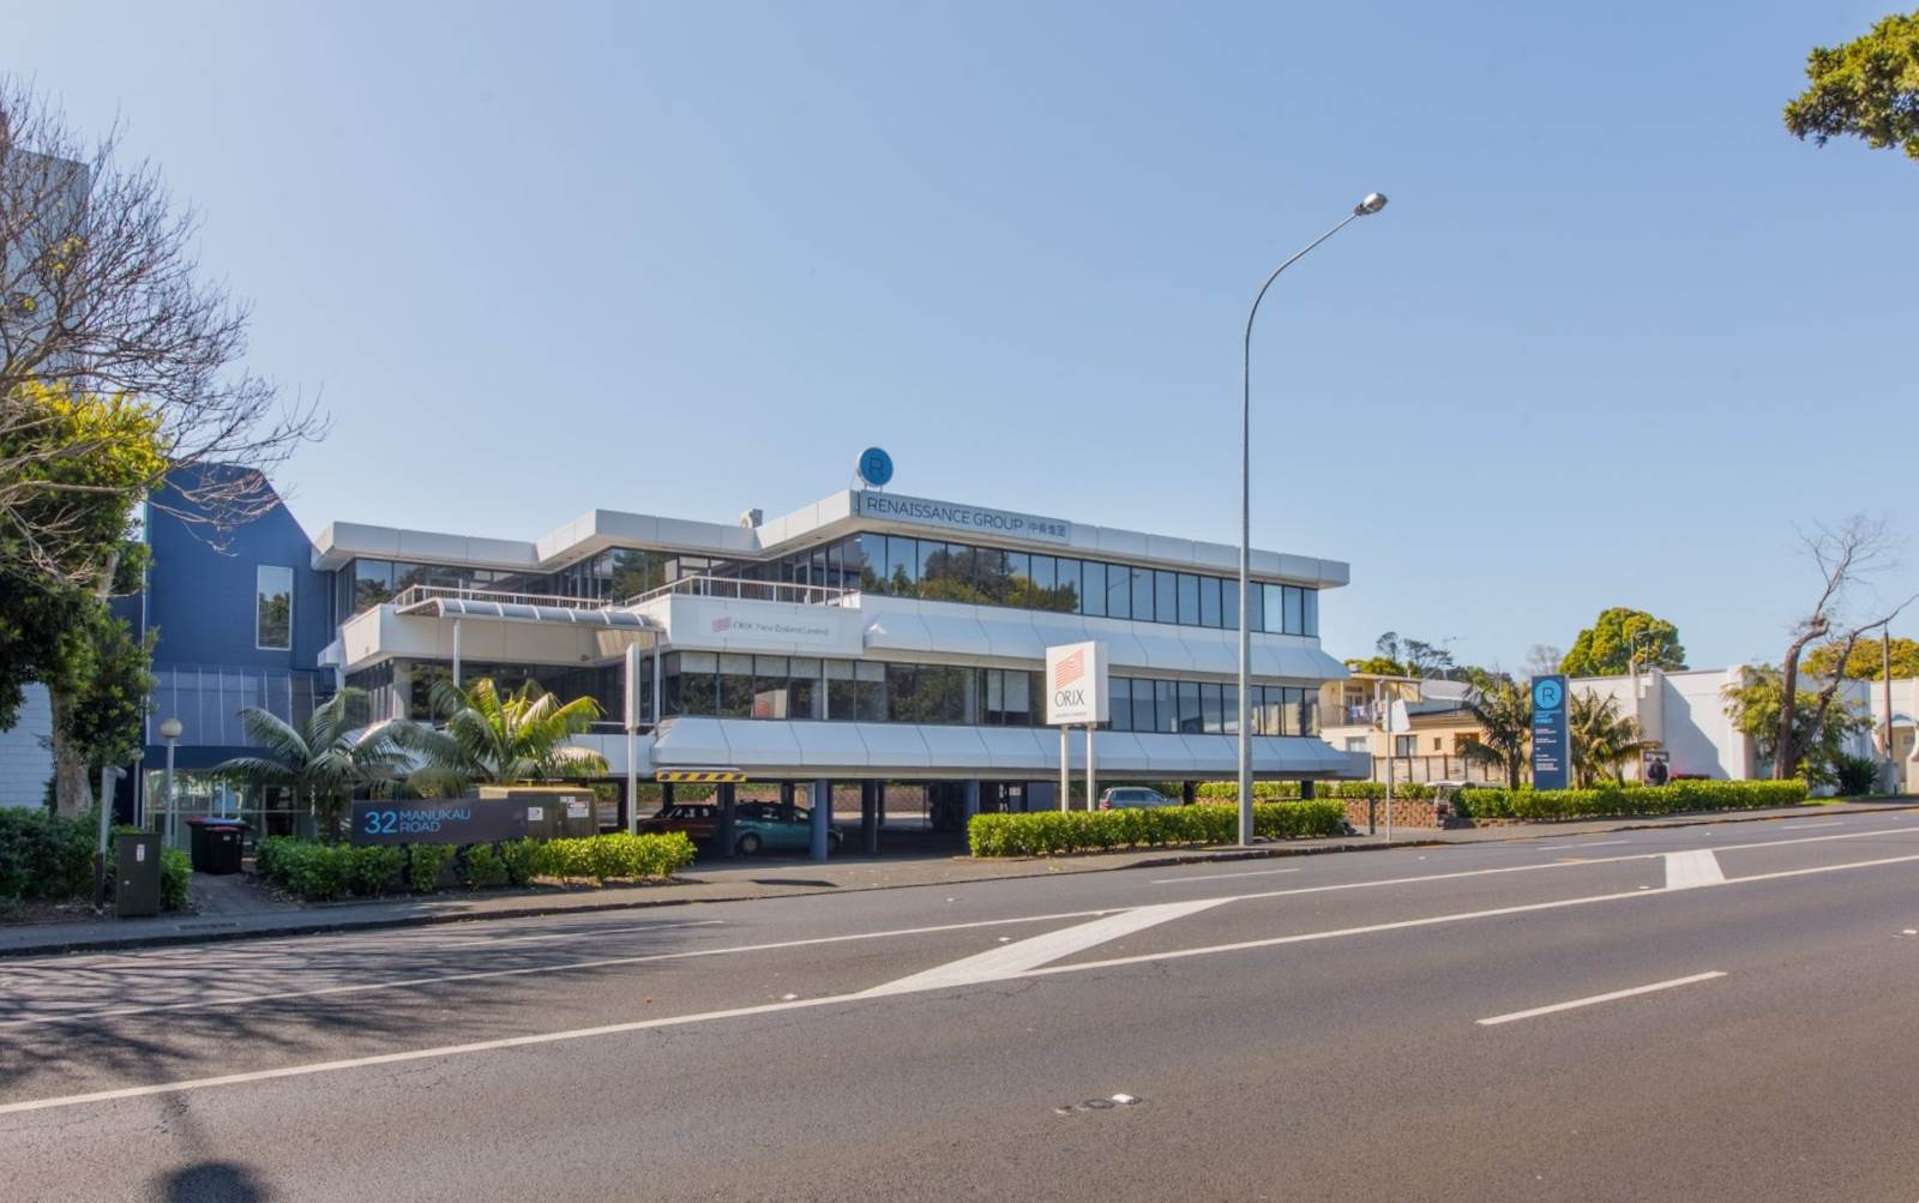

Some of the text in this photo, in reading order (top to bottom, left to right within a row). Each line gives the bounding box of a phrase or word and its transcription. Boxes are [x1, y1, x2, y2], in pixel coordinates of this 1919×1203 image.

[867, 497, 1024, 530] RENAISSANCE GROUP
[1055, 689, 1085, 708] ORIX
[365, 811, 398, 834] 32
[400, 808, 471, 821] MANUKAU
[400, 821, 440, 833] ROAD
